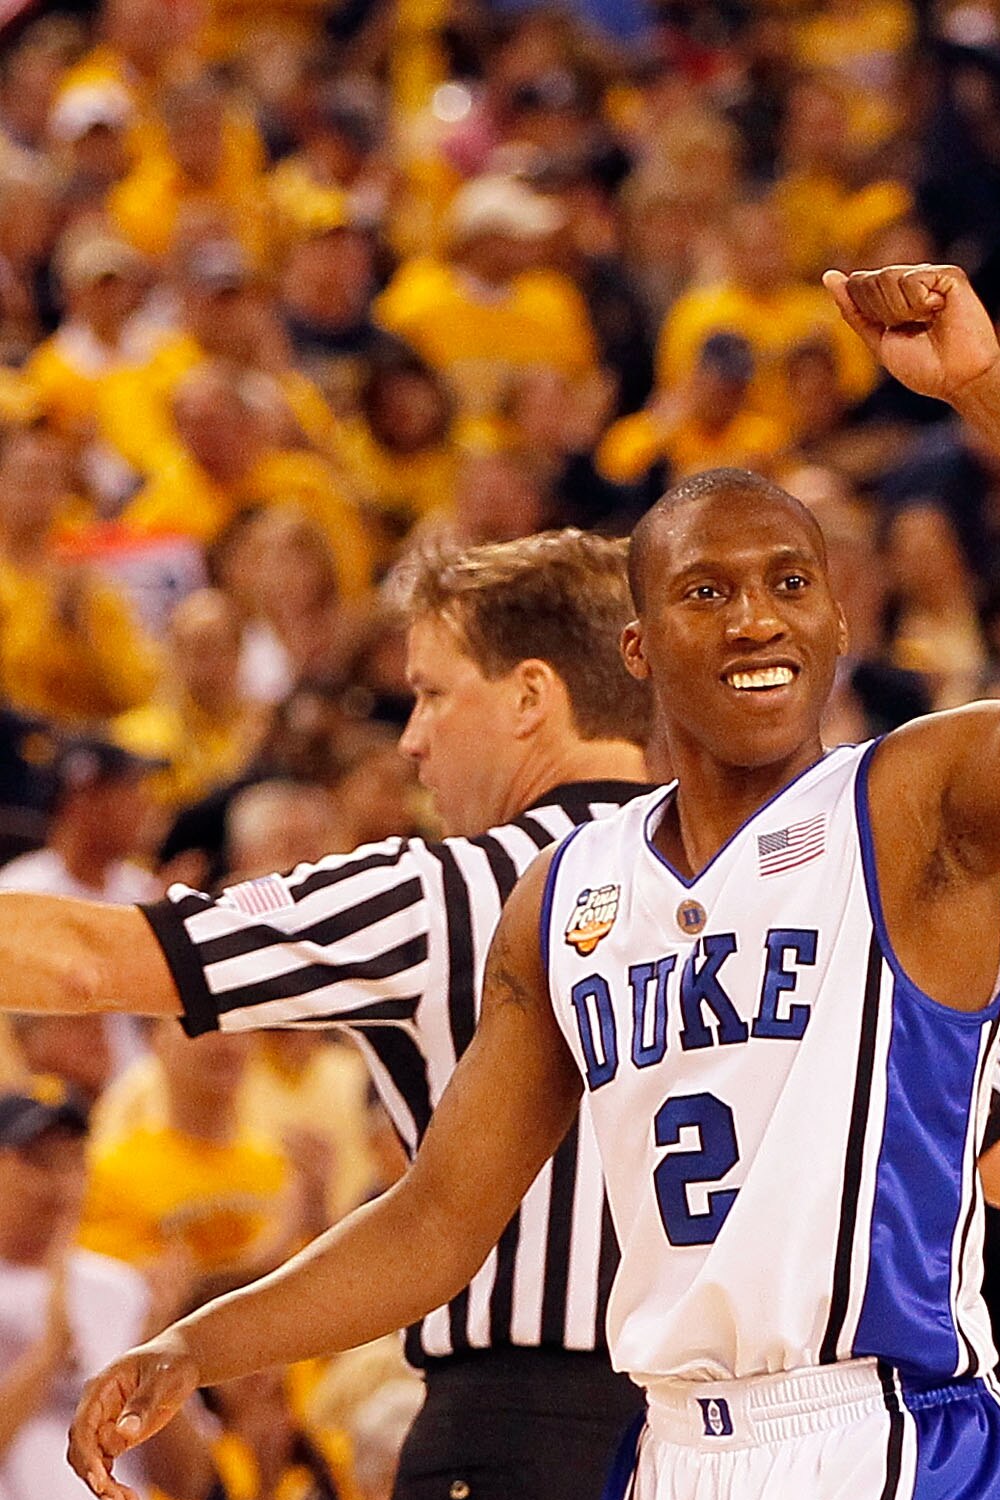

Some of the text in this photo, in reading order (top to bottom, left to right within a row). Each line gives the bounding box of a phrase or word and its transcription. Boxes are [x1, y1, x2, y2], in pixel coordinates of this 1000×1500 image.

[567, 902, 617, 932] FOUR
[570, 928, 819, 1092] DUKE
[653, 1091, 741, 1247] 2
